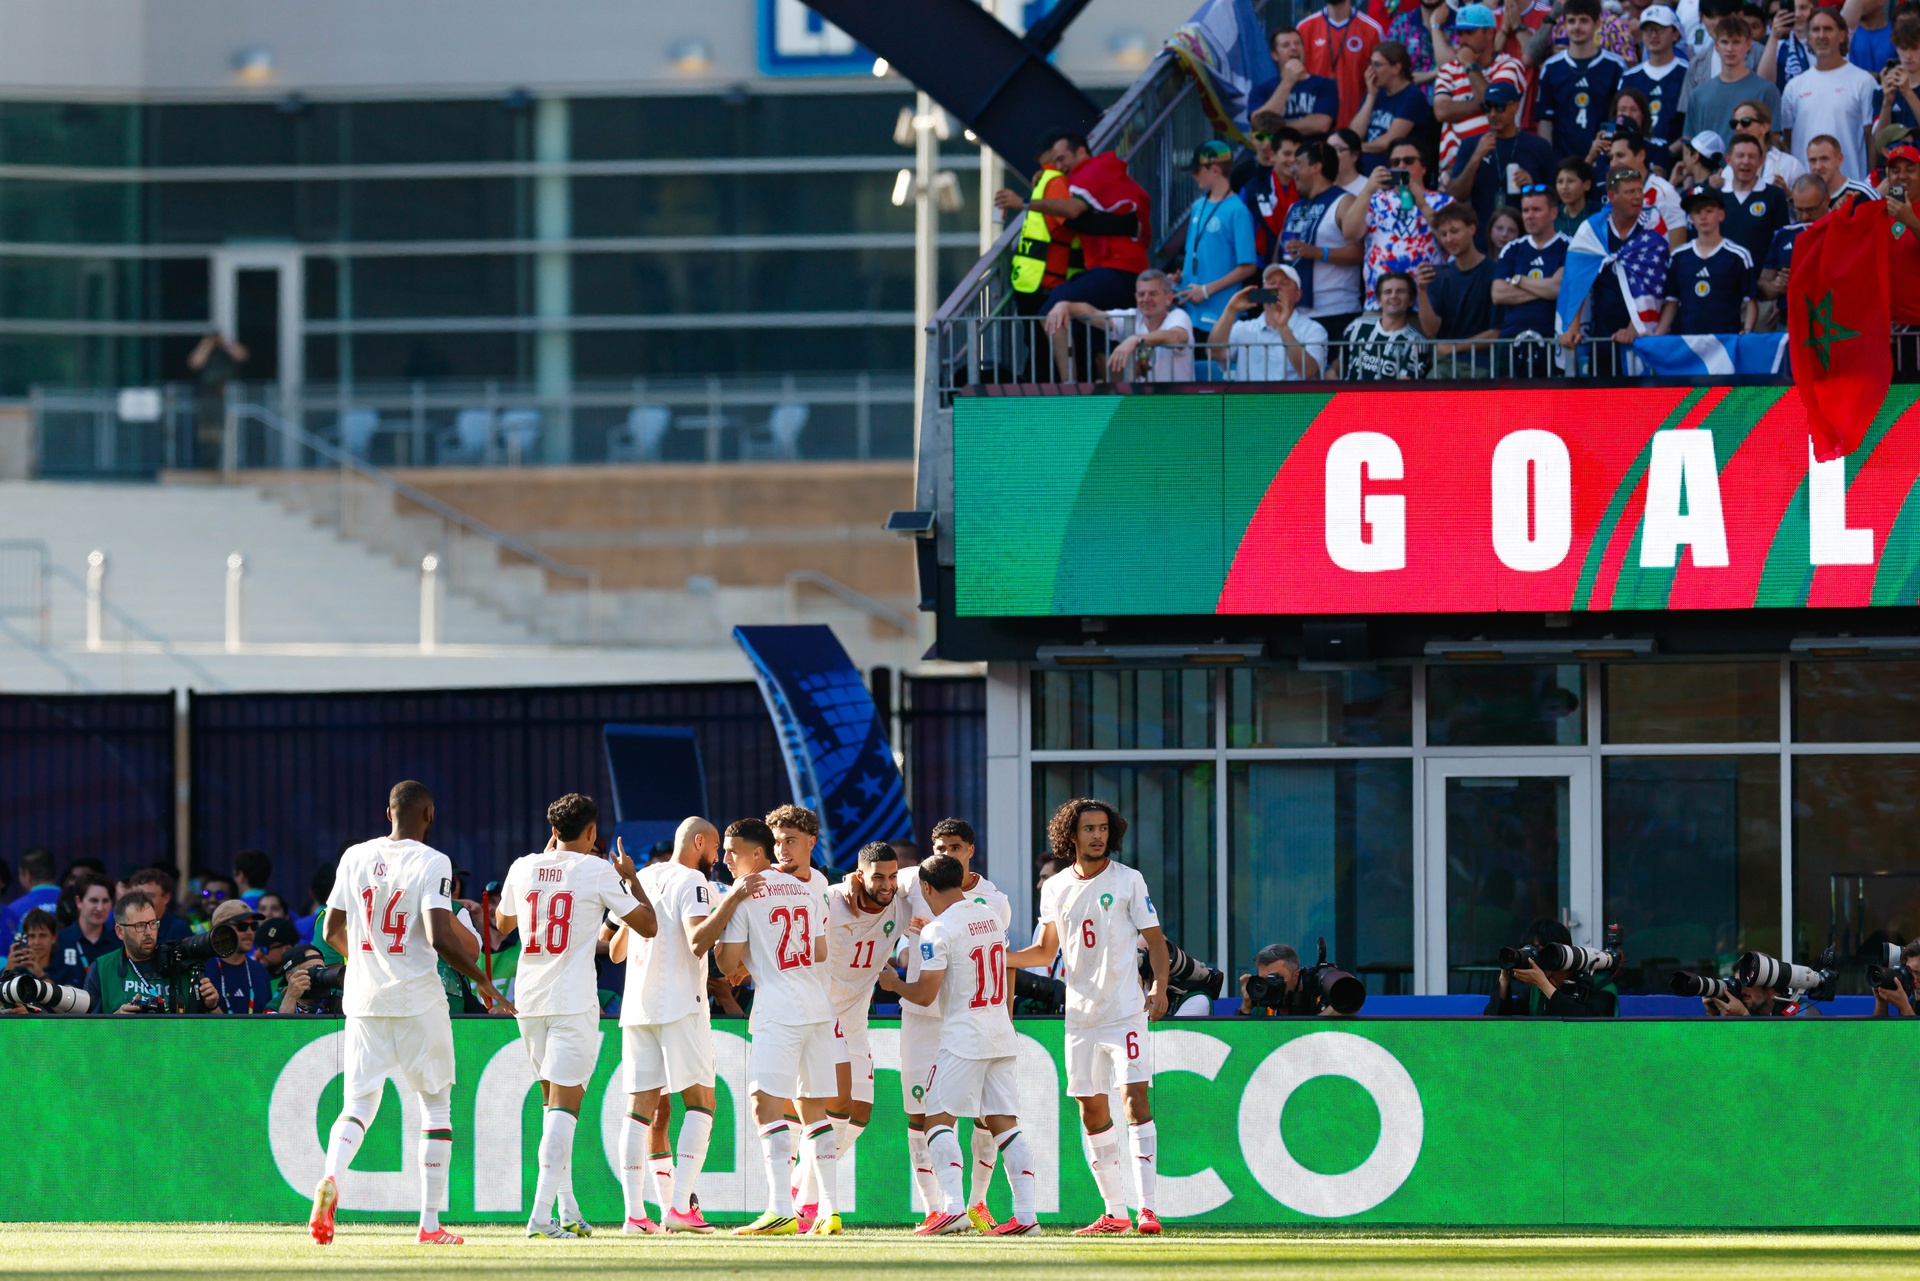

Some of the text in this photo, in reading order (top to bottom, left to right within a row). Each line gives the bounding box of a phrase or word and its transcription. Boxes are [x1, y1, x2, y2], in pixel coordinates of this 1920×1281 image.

[1575, 108, 1588, 129] 4
[1324, 428, 1875, 572] GOAL
[538, 868, 563, 882] RIAD
[361, 886, 410, 956] 14
[524, 889, 575, 956] 18
[967, 919, 998, 936] BRAHIM
[1082, 919, 1096, 949] 6
[768, 905, 813, 972] 23
[849, 940, 875, 969] 11
[968, 940, 1007, 1011] 10
[1125, 1031, 1140, 1060] 6
